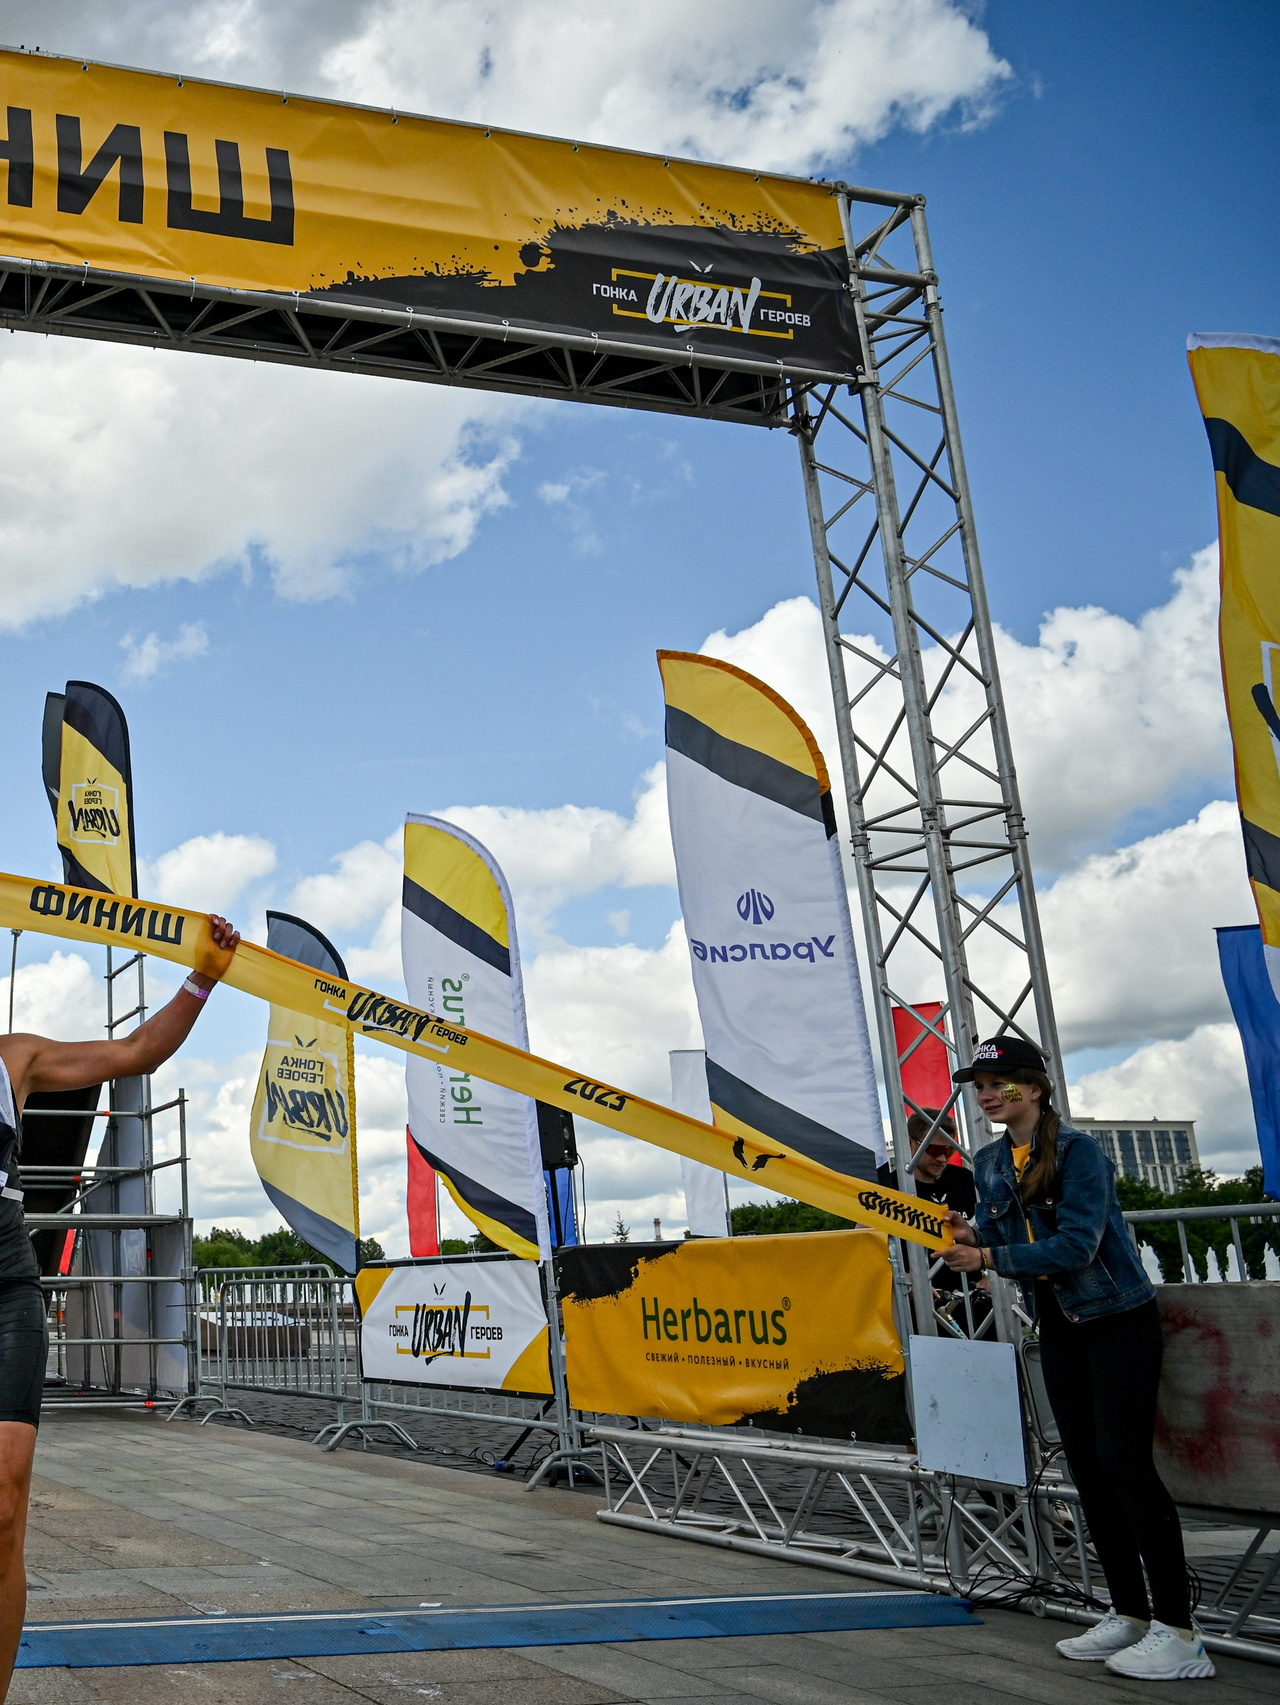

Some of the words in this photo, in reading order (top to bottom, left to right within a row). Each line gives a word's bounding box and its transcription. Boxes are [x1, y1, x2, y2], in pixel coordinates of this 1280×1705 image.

[592, 283, 638, 302] ГОНКА
[646, 272, 762, 333] URBAN
[760, 308, 812, 327] ГЕРОЕВ
[29, 884, 185, 946] ФИНИШ
[314, 978, 347, 1000] ГОНКА
[430, 1024, 469, 1046] ГЕРОЕВ
[858, 1191, 945, 1239] ФИНИШ
[388, 1324, 410, 1338] ГОНКА
[411, 1290, 472, 1359] URBAN
[470, 1326, 504, 1341] ГЕРОЕВ
[641, 1296, 788, 1346] Herbarus
[645, 1352, 680, 1363] СВЕЖИЙ
[687, 1354, 736, 1367] ПОЛЕЗНЫЙ
[745, 1358, 790, 1371] ВКУСНЫЙ
